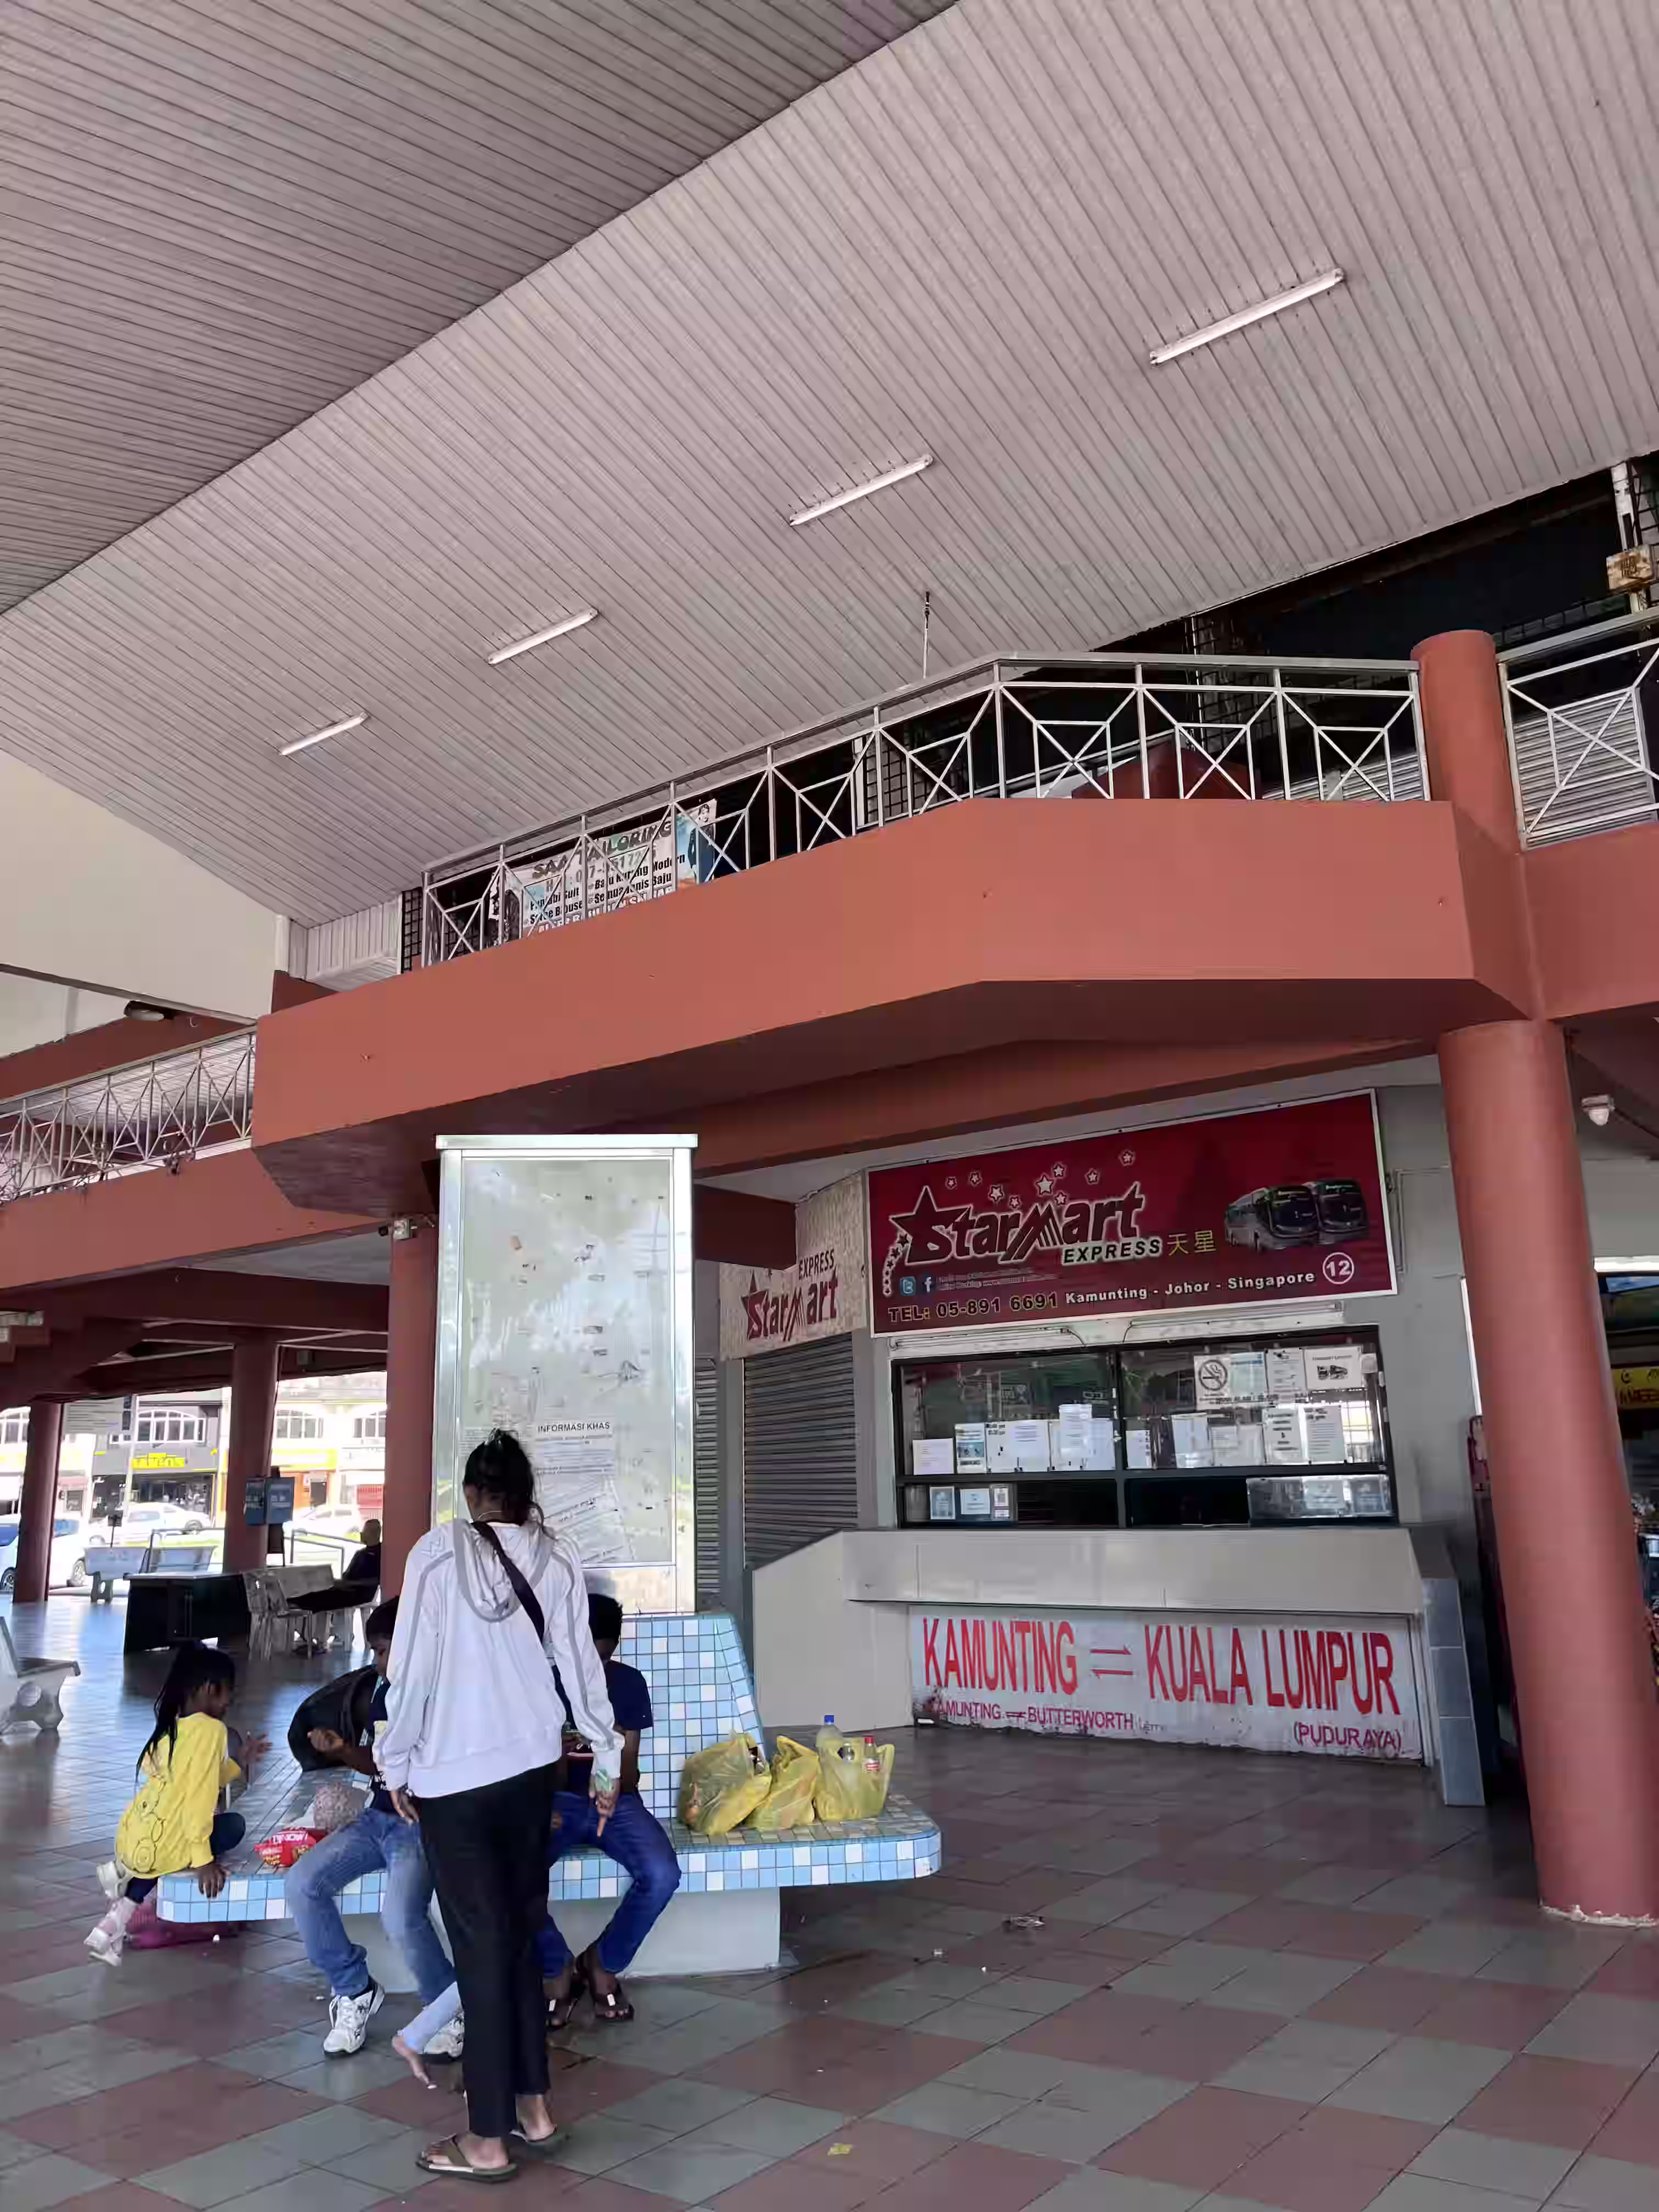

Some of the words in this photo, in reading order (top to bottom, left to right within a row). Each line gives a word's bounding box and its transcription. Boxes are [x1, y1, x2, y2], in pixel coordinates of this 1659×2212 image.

[1063, 1239, 1161, 1263] EXPRESS
[1167, 1231, 1216, 1255] 天星
[799, 1249, 834, 1280] EXPRESS
[1326, 1260, 1351, 1277] 12
[1065, 1285, 1148, 1304] Kamunting
[1165, 1281, 1210, 1295] Johor
[1228, 1272, 1315, 1290] Singapore
[888, 1305, 930, 1322] TEL:
[936, 1297, 1001, 1318] 05-891
[1009, 1292, 1058, 1311] 6691
[538, 1423, 584, 1433] INFORMASI
[587, 1422, 610, 1430] KHAS
[923, 1617, 1079, 1695] KAMUNTING
[1144, 1624, 1253, 1706] KUALA
[1262, 1628, 1401, 1716] LUMPUR
[1028, 1706, 1133, 1731] BUTTERWORTH
